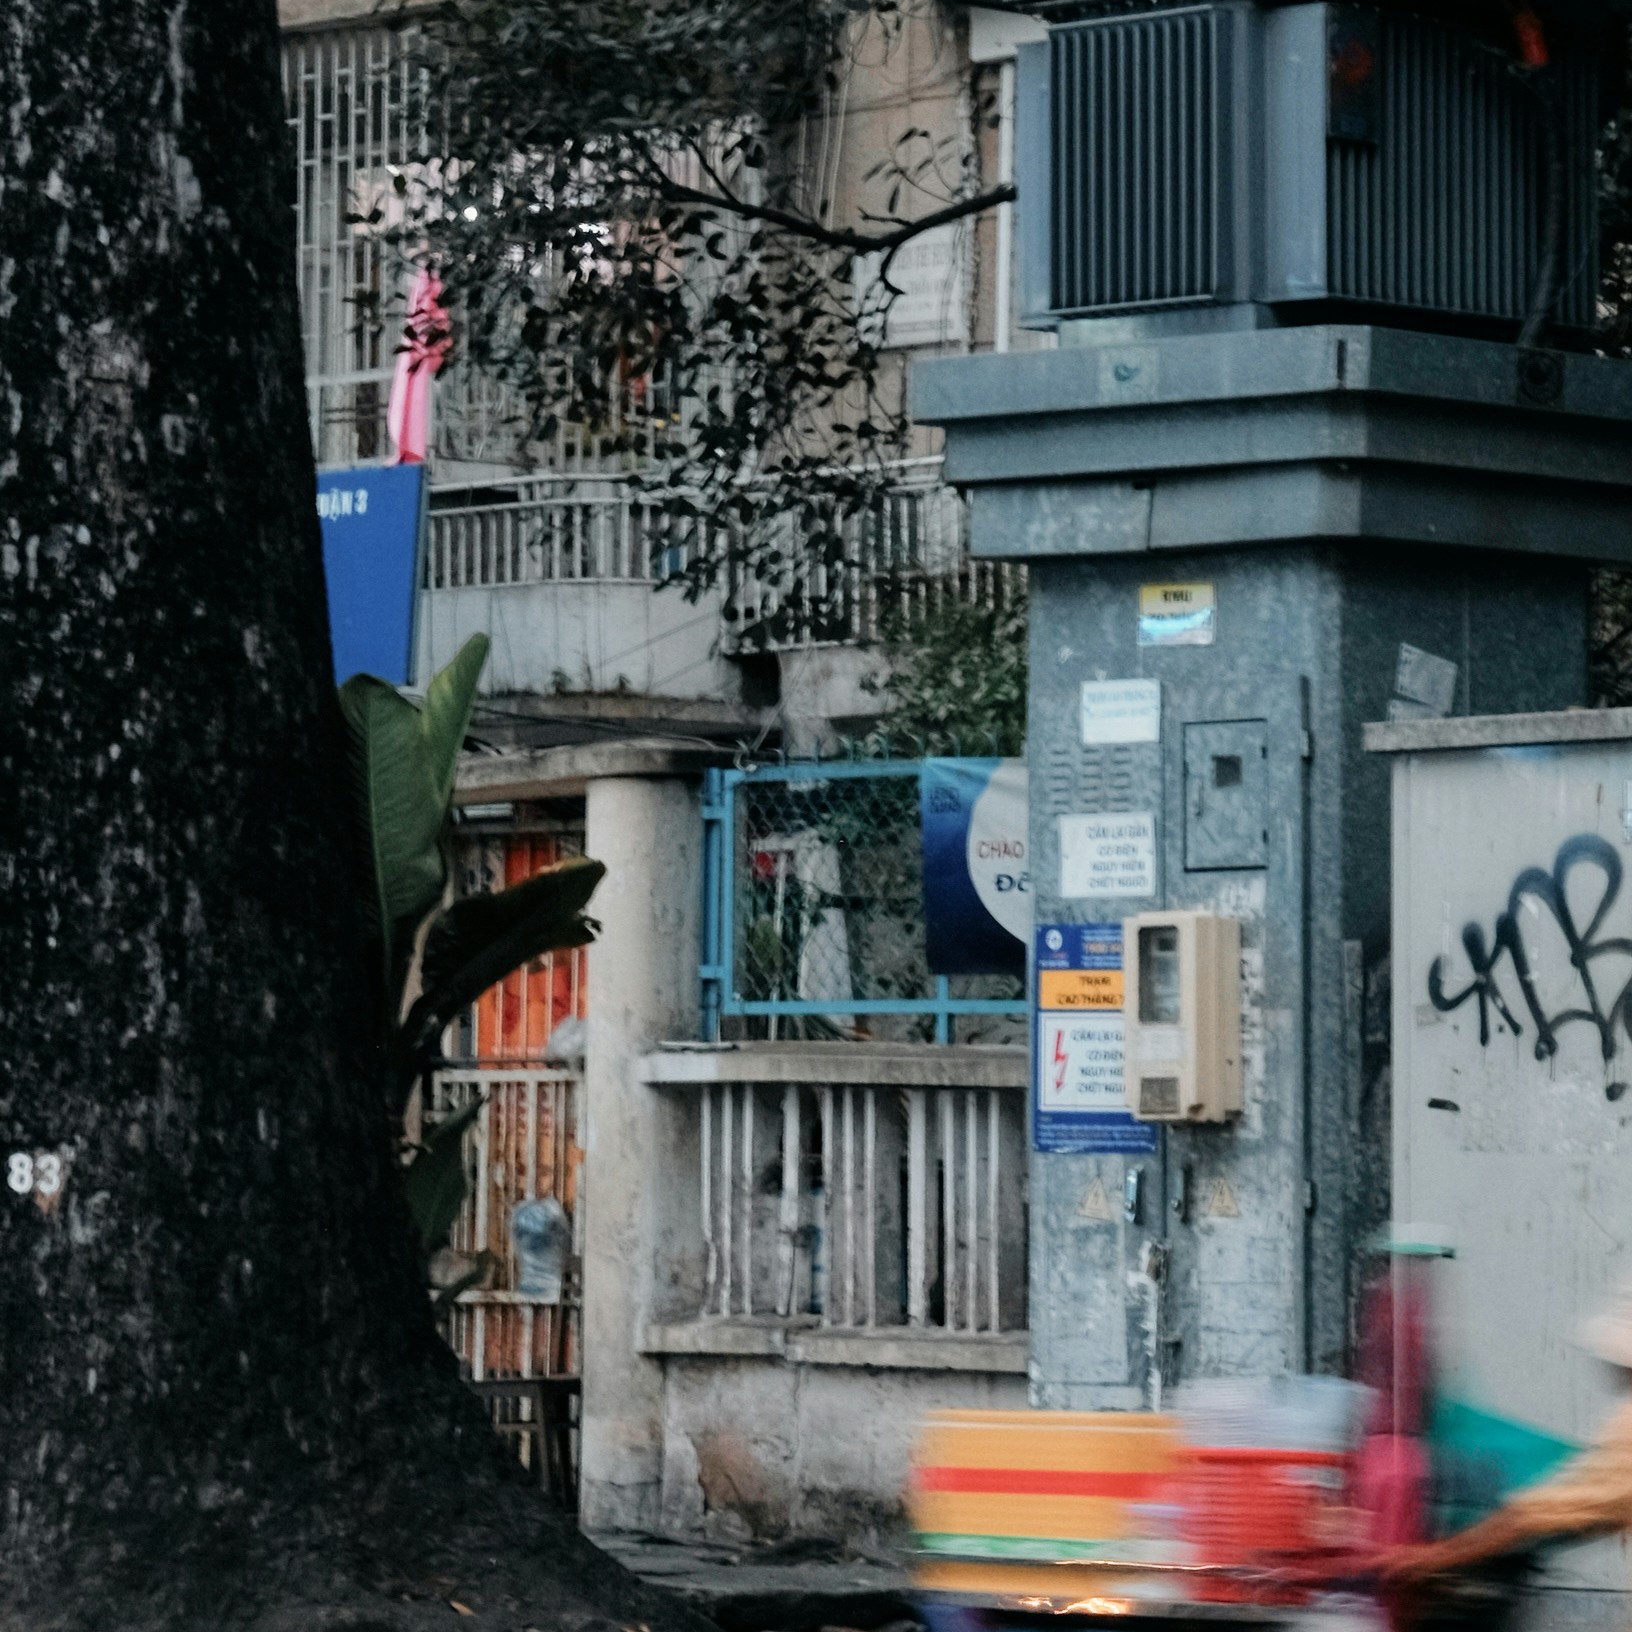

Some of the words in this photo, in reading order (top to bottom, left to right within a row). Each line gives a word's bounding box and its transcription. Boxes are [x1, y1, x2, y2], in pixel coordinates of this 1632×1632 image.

[316, 486, 353, 521] UẬN
[354, 488, 368, 514] 3
[7, 1150, 61, 1177] 83
